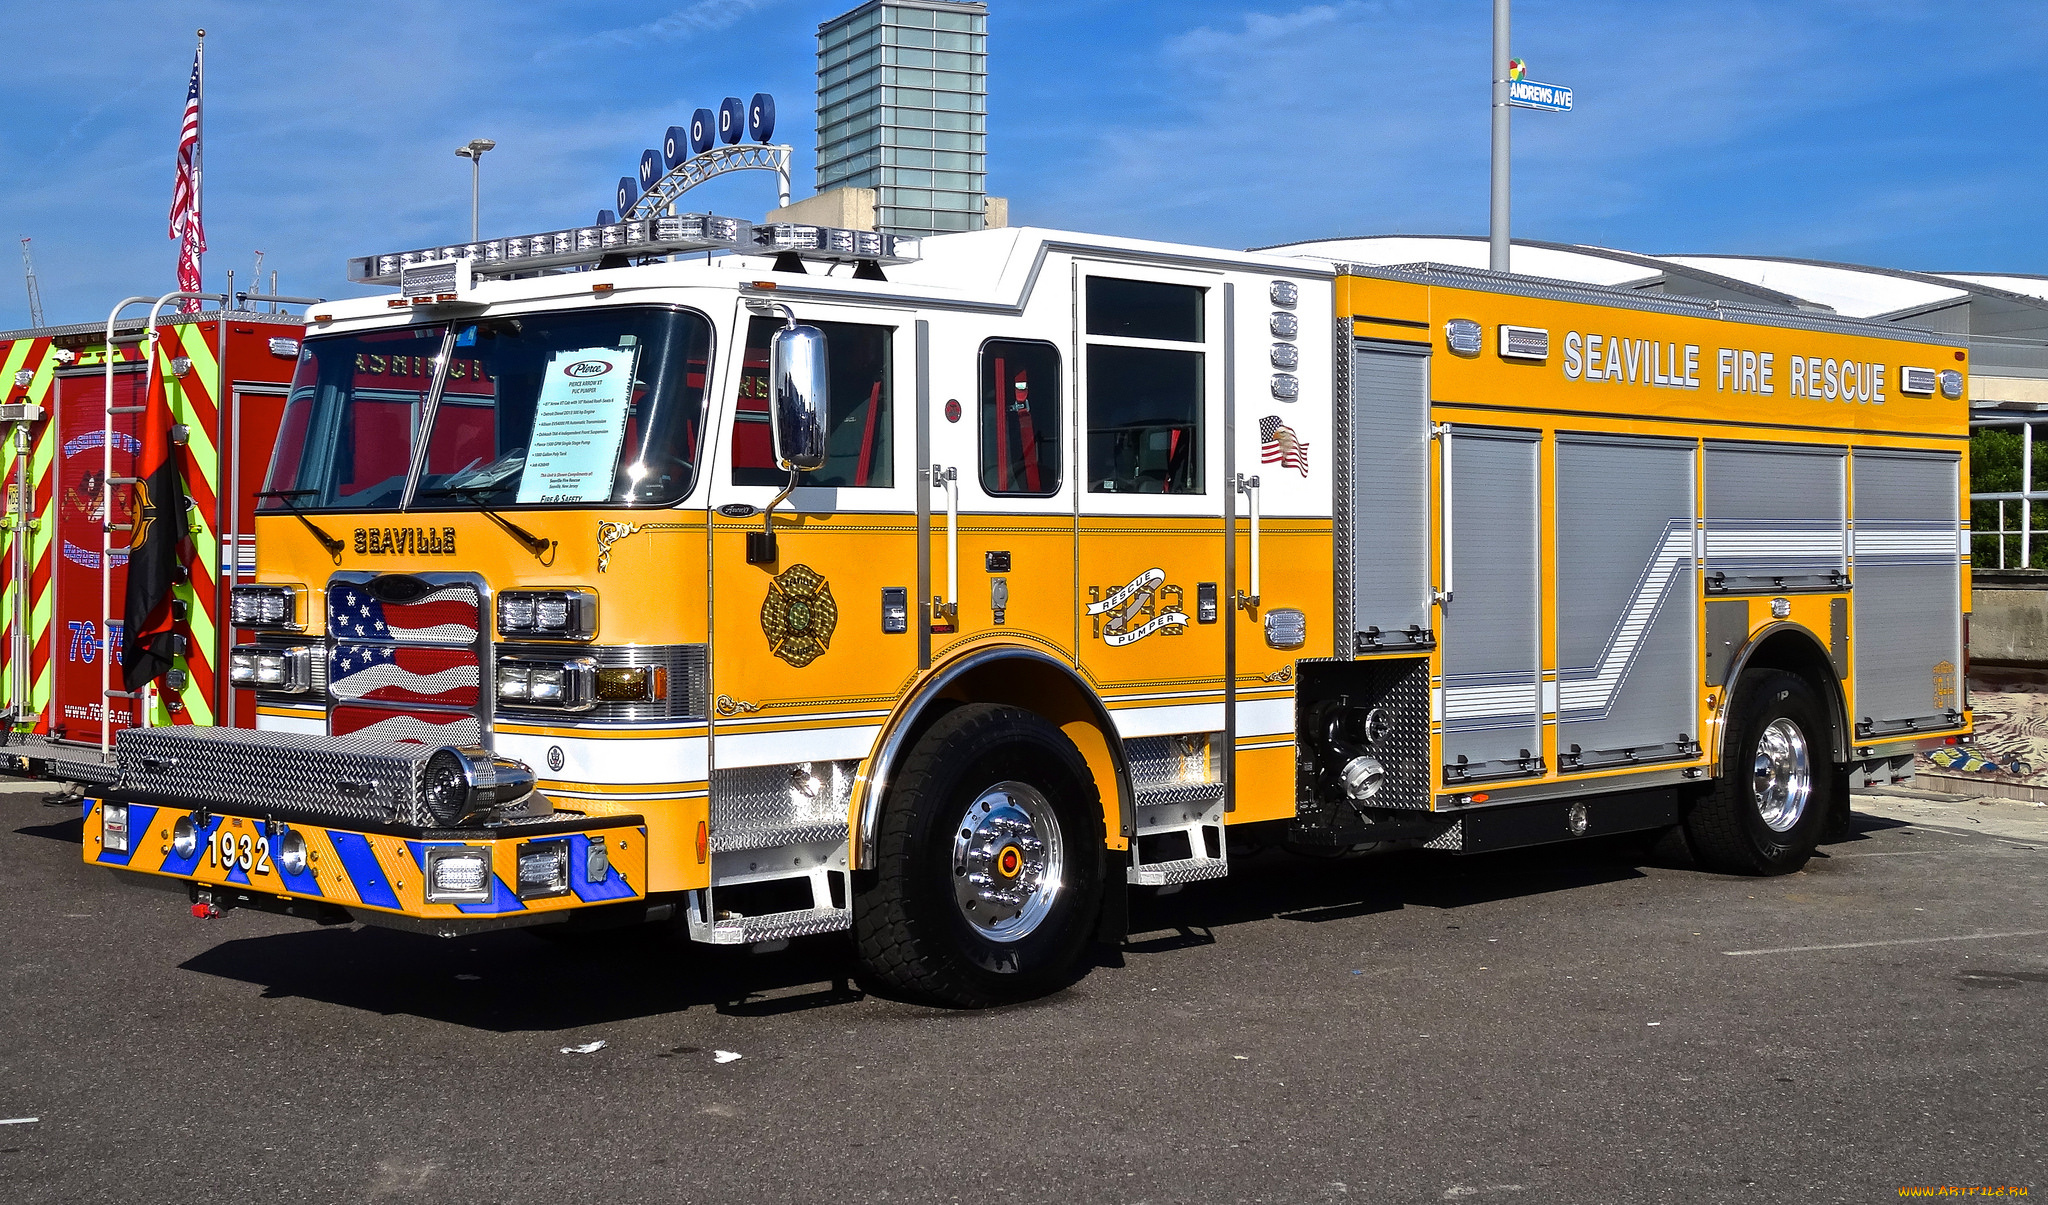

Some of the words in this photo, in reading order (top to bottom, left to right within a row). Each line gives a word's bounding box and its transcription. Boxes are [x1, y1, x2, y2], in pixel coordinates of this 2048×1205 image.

[1510, 83, 1552, 103] ANDREWS
[1553, 90, 1572, 107] AVE
[573, 362, 602, 375] Pierce
[1564, 331, 1700, 388] SEAVILLE
[1717, 347, 1774, 396] FIRE
[1791, 354, 1886, 404] RESCUE
[354, 527, 457, 555] SEAVILLE
[1102, 571, 1151, 610] RESCUE
[1118, 614, 1174, 644] PUMPER
[208, 830, 271, 876] 1932
